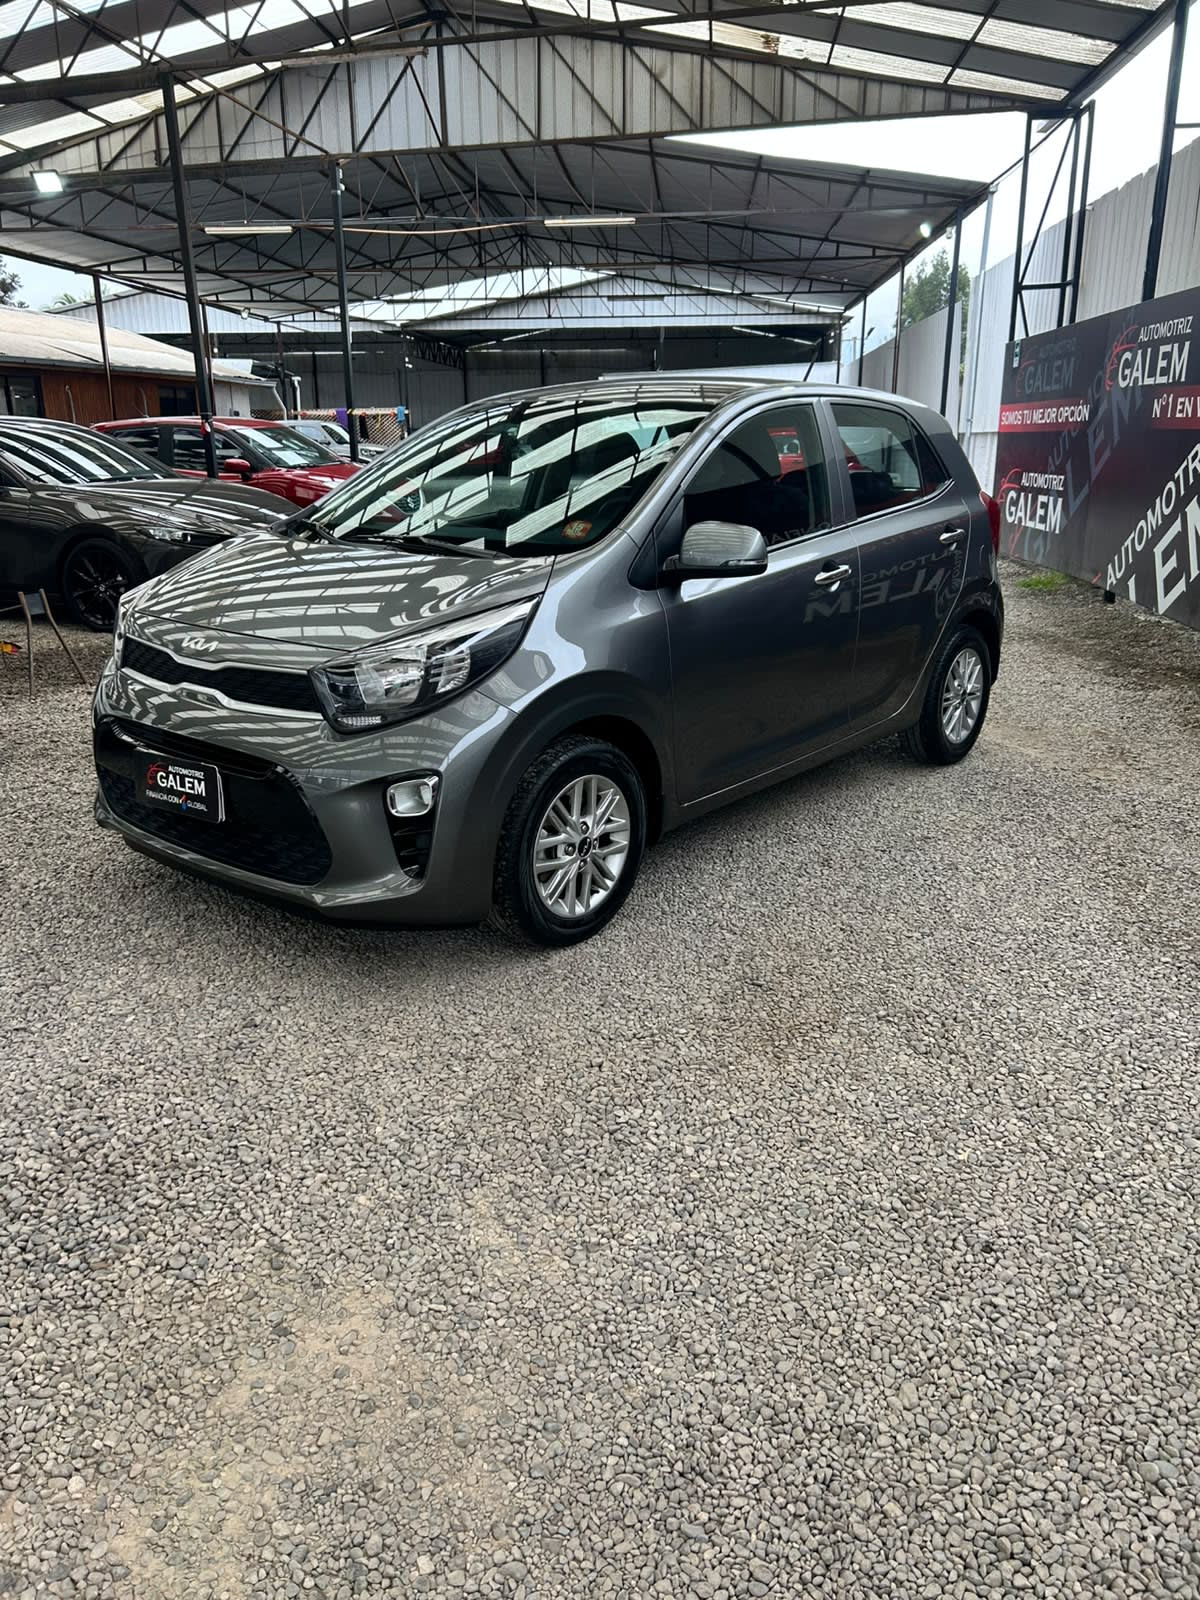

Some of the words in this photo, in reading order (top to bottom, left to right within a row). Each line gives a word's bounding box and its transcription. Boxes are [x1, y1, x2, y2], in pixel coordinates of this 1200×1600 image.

[1138, 316, 1193, 342] AUTOMOTRIZ
[1118, 341, 1190, 389] GALEM
[1001, 411, 1022, 425] SOMOS
[1023, 409, 1033, 424] TU
[1033, 407, 1056, 423] MEJOR
[1057, 400, 1090, 422] OPCIÓN
[1175, 397, 1194, 418] EN
[1021, 471, 1065, 491] AUTOMOTRIZ
[1005, 490, 1063, 534] GALEM
[157, 771, 206, 797] GALEM
[168, 765, 204, 779] AUTOMOTRIZ
